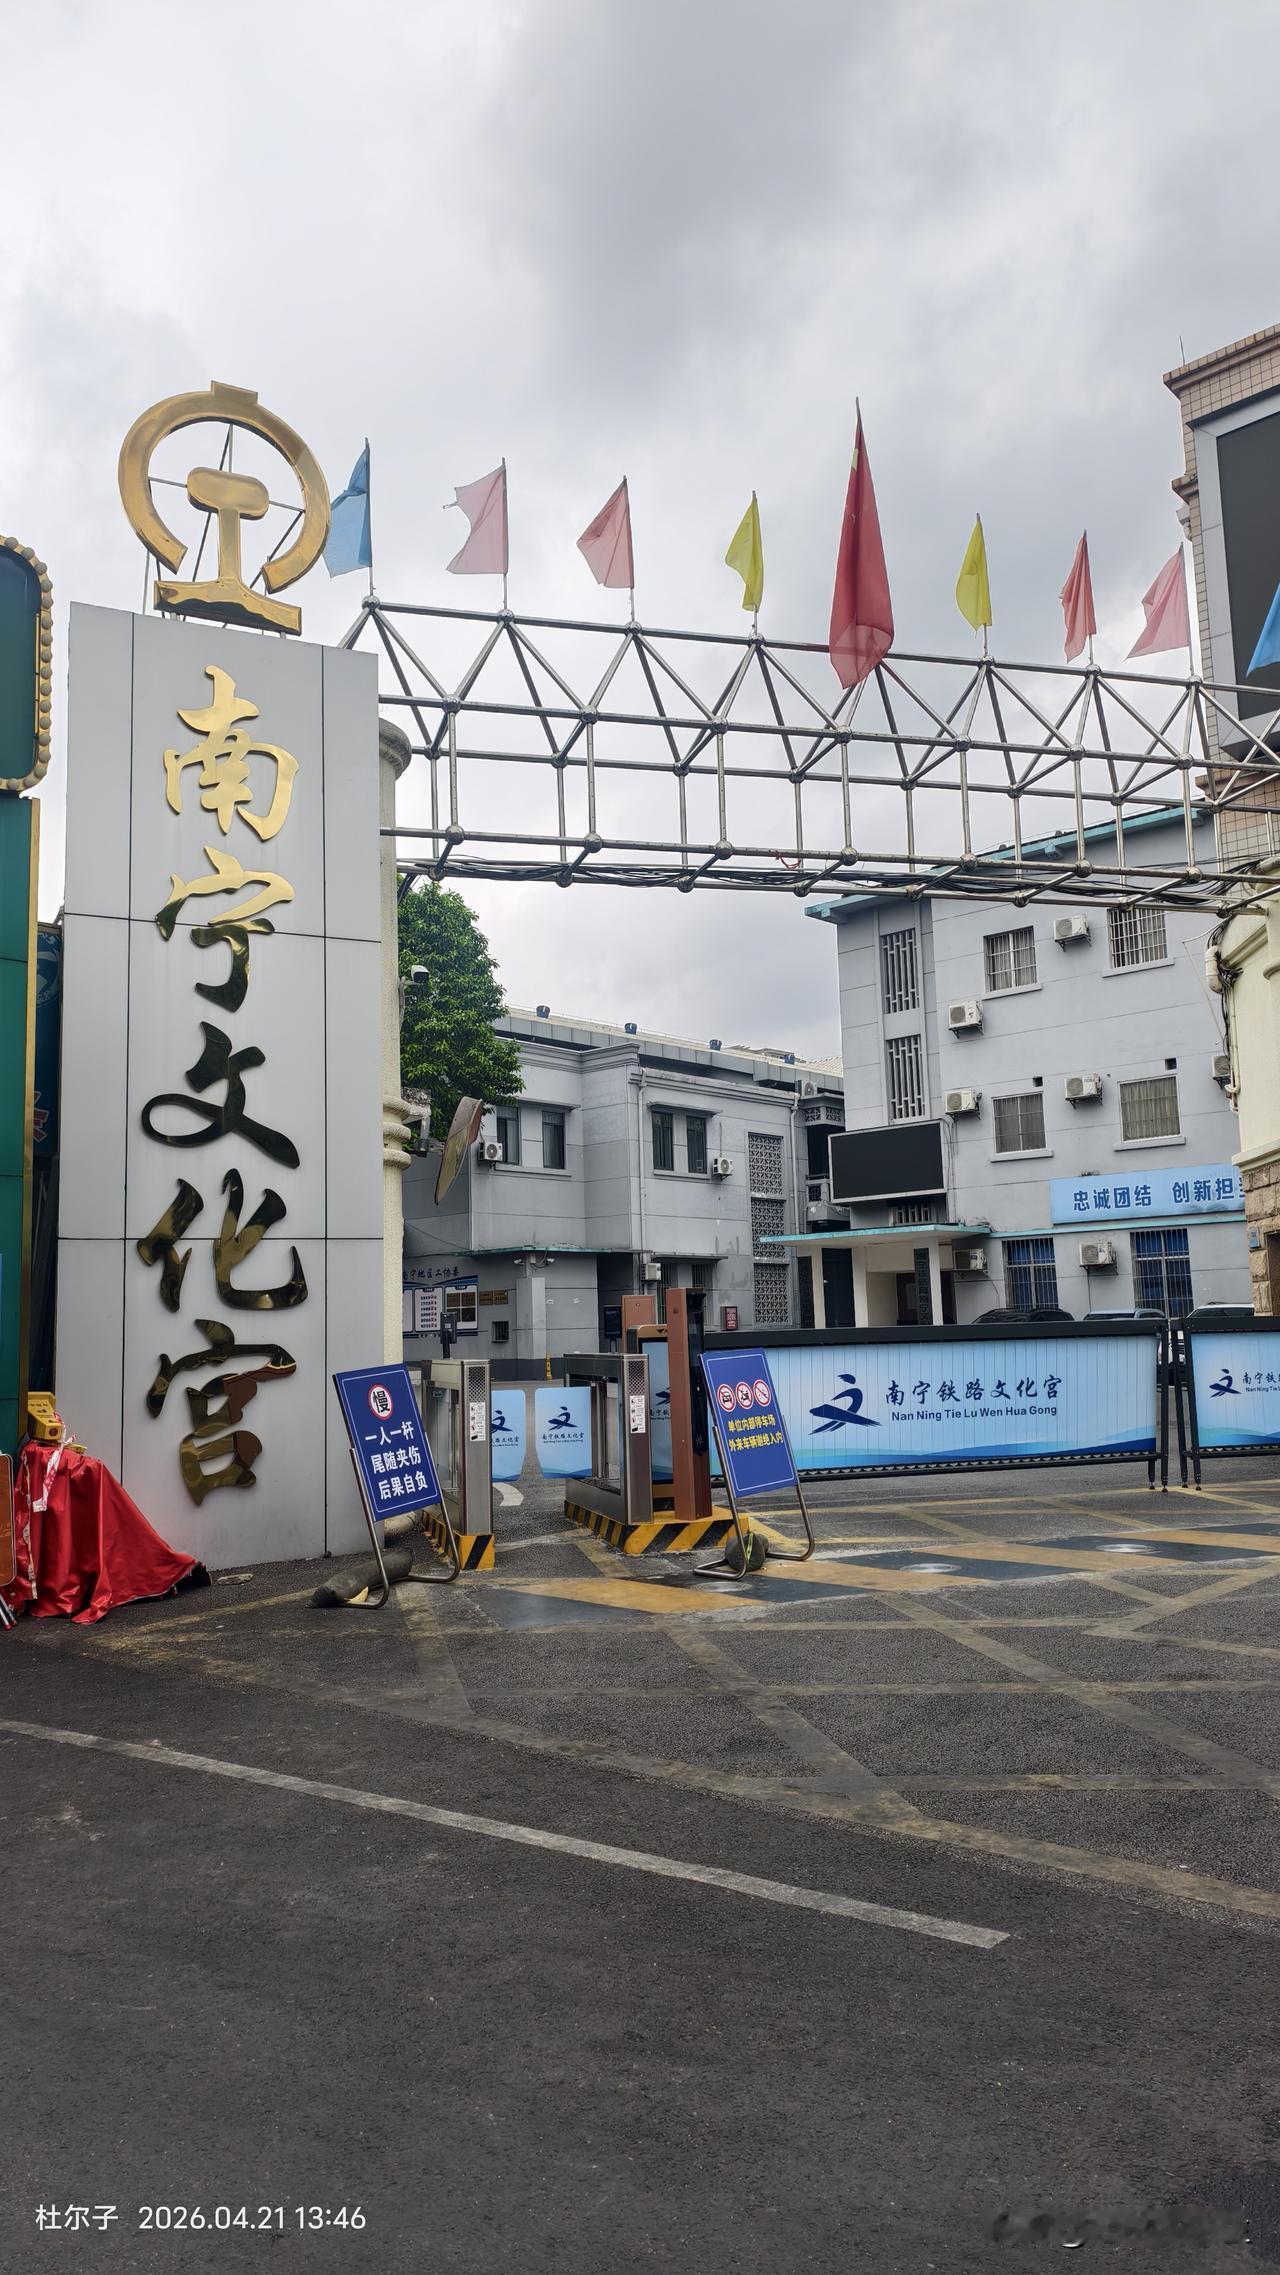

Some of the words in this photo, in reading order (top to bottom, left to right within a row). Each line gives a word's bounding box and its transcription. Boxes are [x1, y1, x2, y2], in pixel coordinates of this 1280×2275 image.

[136, 664, 307, 1507] 南宁文化宫
[1073, 1184, 1152, 1211] 忠诚团结
[886, 1374, 1062, 1406] 南宁铁路文化宫
[1242, 1371, 1280, 1385] 南宁铁
[372, 1390, 391, 1413] 慢
[892, 1411, 914, 1421] Nan
[916, 1410, 942, 1422] Ning
[944, 1409, 962, 1419] Tie
[964, 1408, 978, 1418] Lu
[979, 1407, 1003, 1418] Wen
[1005, 1406, 1027, 1416] Hua
[1029, 1405, 1057, 1417] Gong
[365, 1421, 414, 1446] 一人一杆
[728, 1414, 776, 1433] 单位内部停车场
[728, 1431, 784, 1452] 外来车辆谢绝入内
[371, 1445, 422, 1475] 尾随夹伤
[378, 1470, 429, 1501] 后果自负
